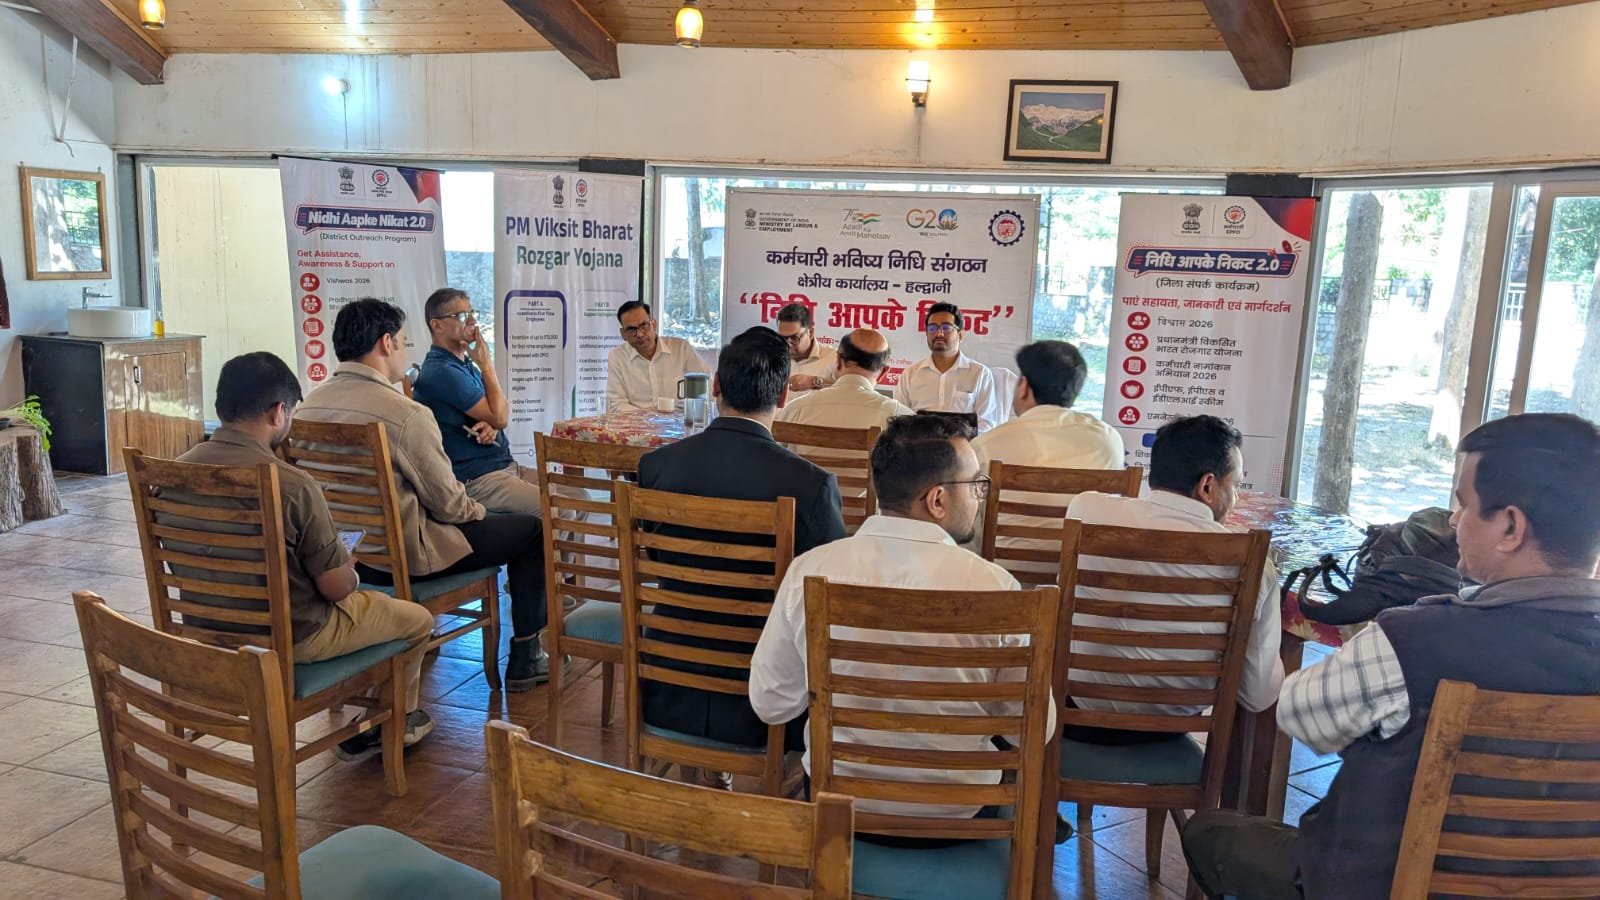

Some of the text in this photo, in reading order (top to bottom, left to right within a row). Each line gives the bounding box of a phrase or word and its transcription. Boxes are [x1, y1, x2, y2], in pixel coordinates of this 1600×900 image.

[308, 211, 426, 228] Nidhi Aapke Nikat 2.0
[506, 216, 633, 241] PM Viksit Bharat
[319, 231, 417, 244] (District Outreach Program)
[857, 232, 891, 240] Mahotsav
[297, 250, 361, 259] Get Assistance,
[516, 246, 623, 271] Rozgar Yojana
[765, 246, 988, 273] कर्मचारी भविष्य निधि संगठन
[1144, 251, 1280, 271] निधि आपके निकट 2.0
[298, 260, 342, 268] Awareness
[352, 260, 383, 270] Support
[797, 273, 832, 289] क्षेत्रीय
[835, 275, 888, 291] कार्यालय
[905, 278, 952, 294] हल्द्वानी
[1156, 277, 1260, 292] (जिला संपर्क कार्यक्रम)
[1141, 297, 1180, 309] सहायता,
[1183, 298, 1224, 310] जानकारी
[1228, 300, 1242, 311] एवं
[1244, 299, 1291, 313] मार्गदर्शन
[828, 298, 907, 331] आपके
[1188, 320, 1214, 328] 2026
[1157, 335, 1236, 347] प्रधानमंत्री विकसित
[1156, 345, 1178, 353] भारत
[1214, 347, 1243, 357] योजना
[1156, 359, 1232, 371] कर्मचारी नामांकन
[1155, 367, 1217, 380] अभियान 2026
